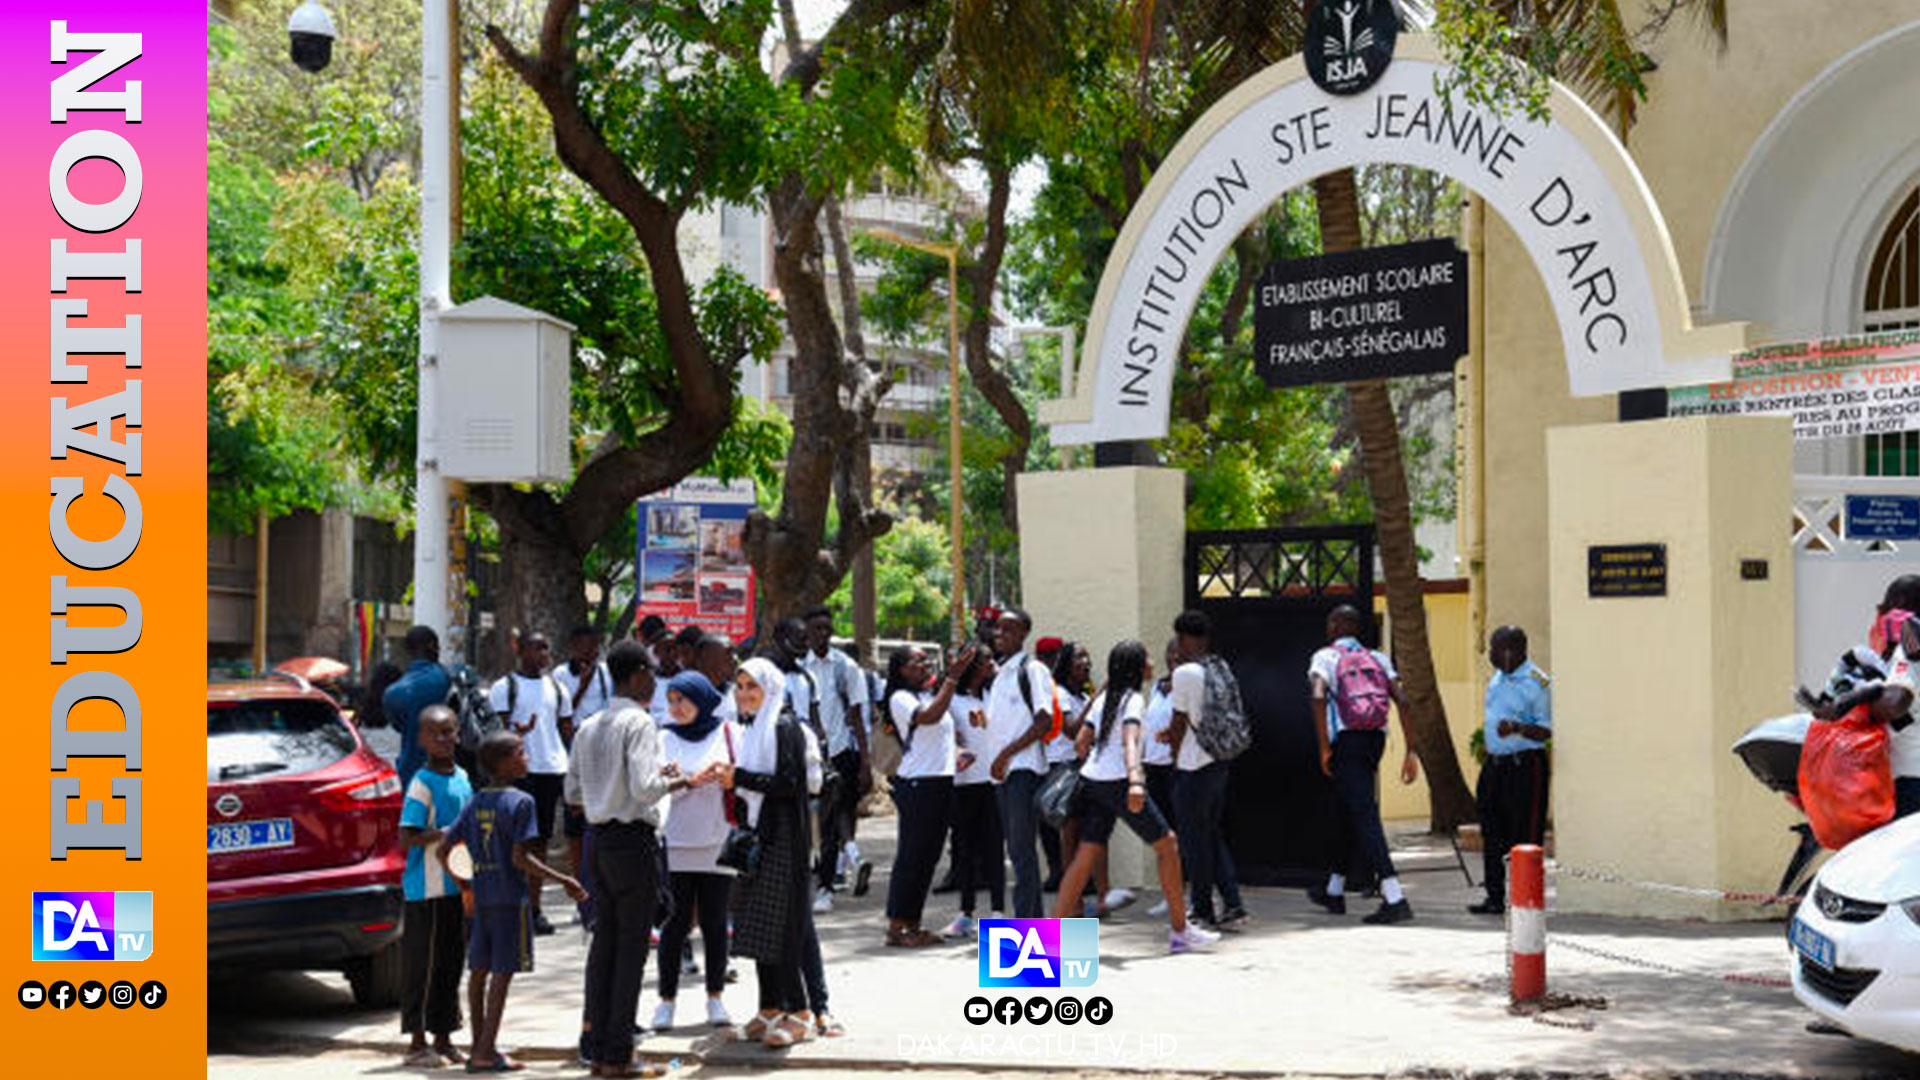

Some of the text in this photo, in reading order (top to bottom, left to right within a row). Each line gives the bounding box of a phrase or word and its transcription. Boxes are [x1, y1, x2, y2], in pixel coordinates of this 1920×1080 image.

[1326, 57, 1368, 82] ISJA
[1118, 94, 1627, 406] INSTITUTION STE JEANNE D'ARC
[1375, 262, 1454, 293] SCOLAIRE
[1309, 300, 1403, 331] BI-CULTUREL
[1708, 371, 1844, 400] EXPOSITION
[1832, 389, 1868, 405] DES
[1836, 407, 1862, 421] AU
[212, 825, 252, 849] 2830
[268, 821, 287, 842] AY
